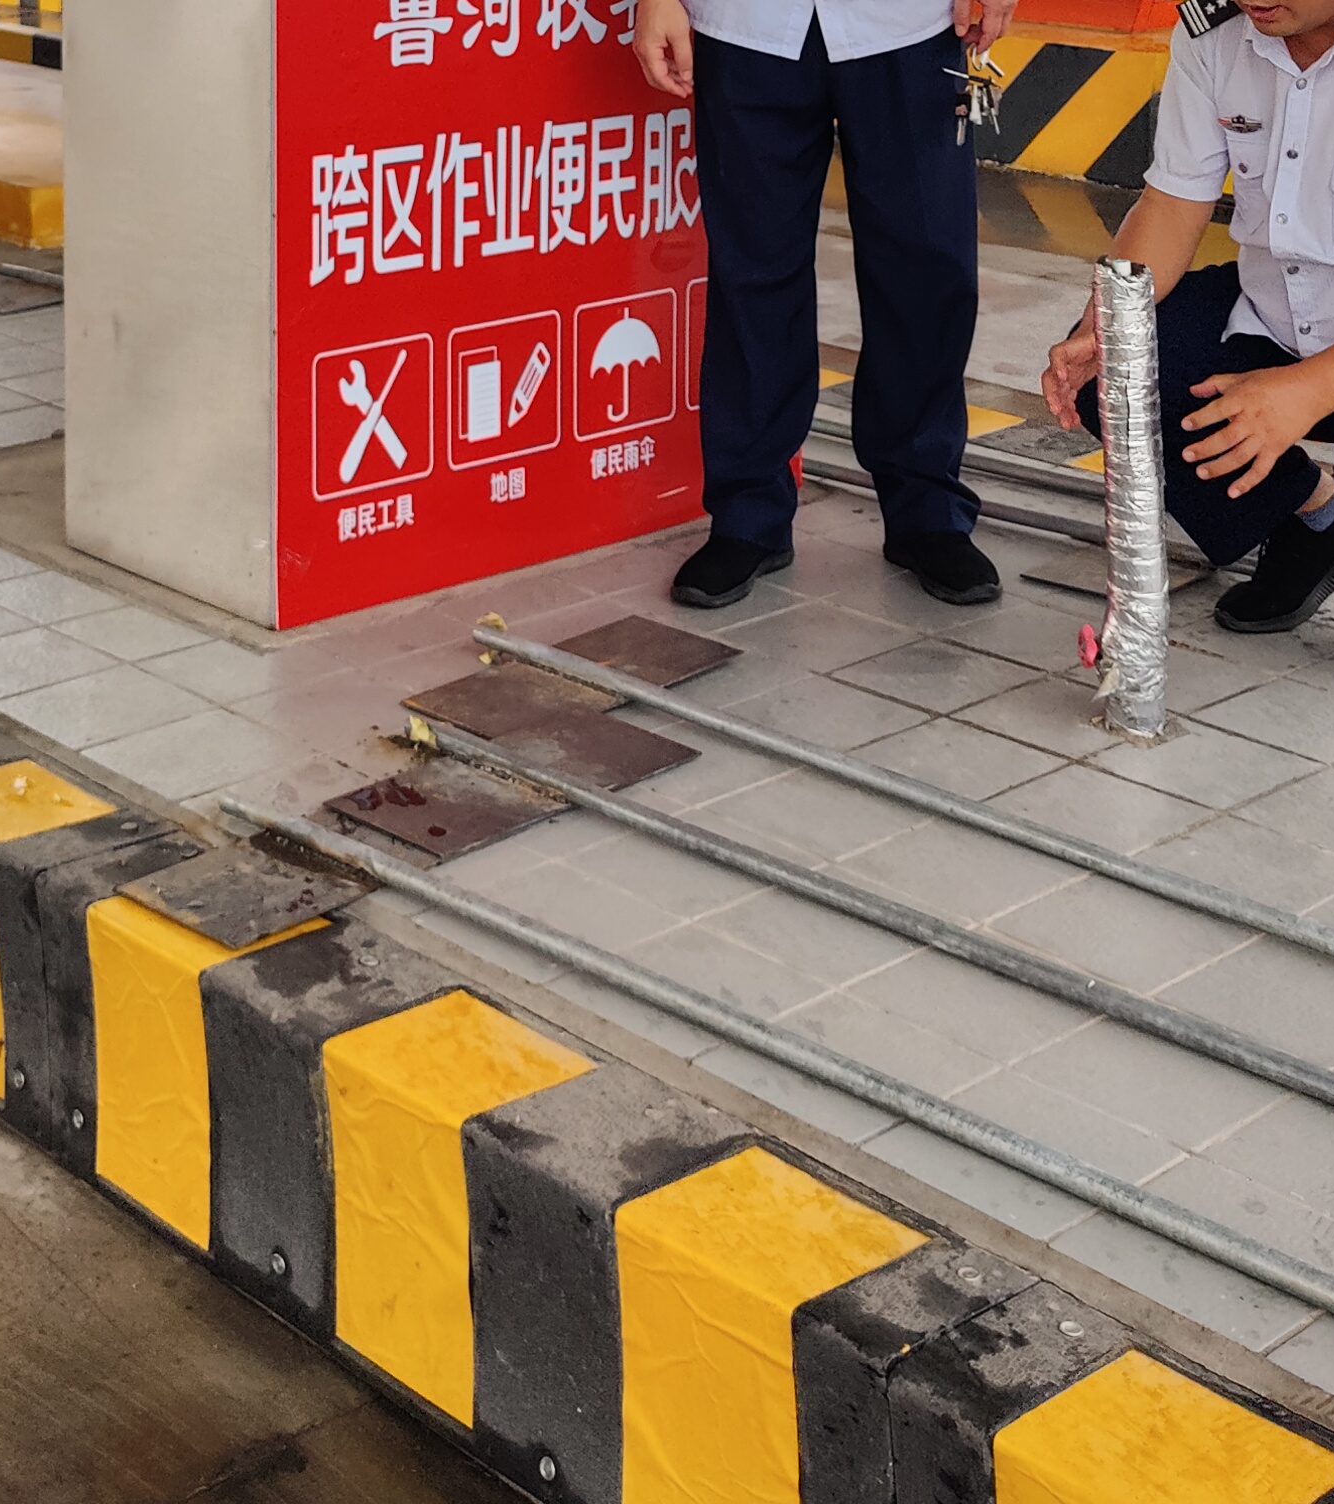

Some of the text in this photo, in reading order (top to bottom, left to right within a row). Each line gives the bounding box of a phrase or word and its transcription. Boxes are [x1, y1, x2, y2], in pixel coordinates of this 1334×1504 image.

[309, 107, 702, 287] 跨区作业便民服
[590, 435, 656, 480] 便民雨伞
[490, 467, 526, 503] 地图
[337, 494, 414, 543] 便民工具
